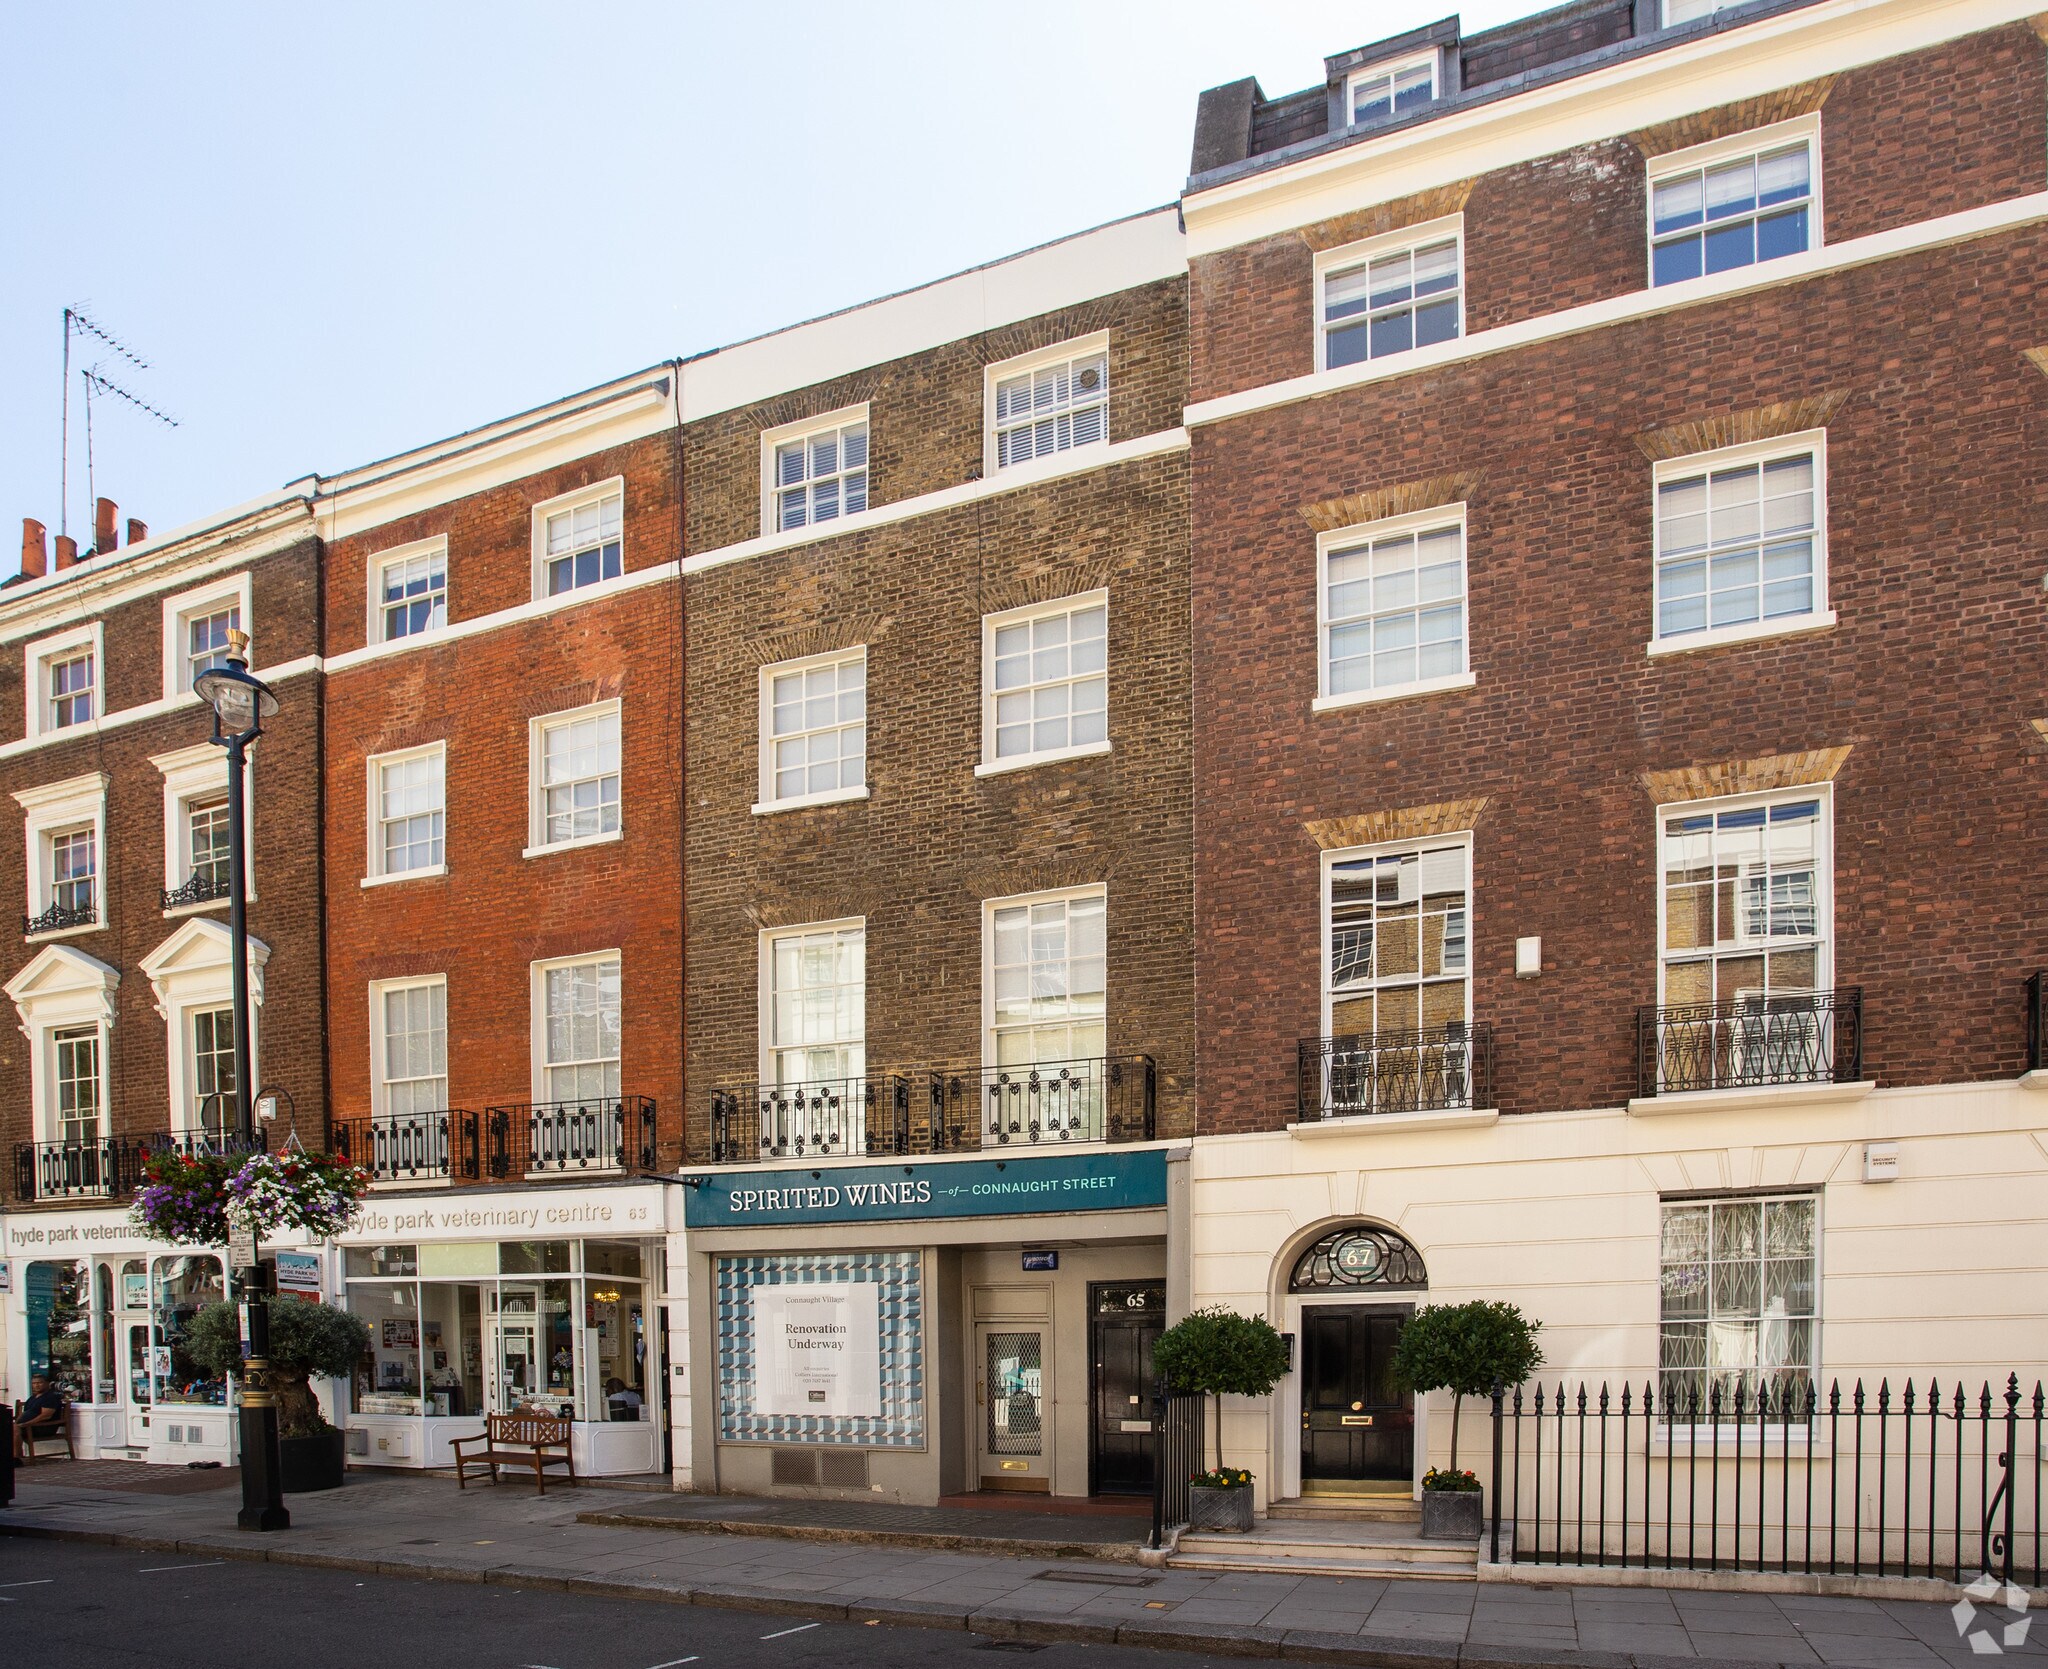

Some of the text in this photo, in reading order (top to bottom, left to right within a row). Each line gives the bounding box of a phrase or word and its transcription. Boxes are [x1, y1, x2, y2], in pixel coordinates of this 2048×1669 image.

[972, 1180, 1059, 1196] CONNAUGHT
[1062, 1176, 1117, 1190] STREET
[730, 1180, 932, 1212] SPIRITED WINES
[394, 1209, 435, 1233] park
[440, 1206, 540, 1228] veterinary
[546, 1202, 613, 1223] centre
[628, 1206, 648, 1220] 63
[11, 1223, 141, 1247] hyde park veterina
[1346, 1249, 1371, 1266] 67
[785, 1296, 845, 1304] Connaught Village
[1126, 1293, 1145, 1307] 65
[785, 1323, 847, 1334] Renovation
[788, 1339, 845, 1351] Underway
